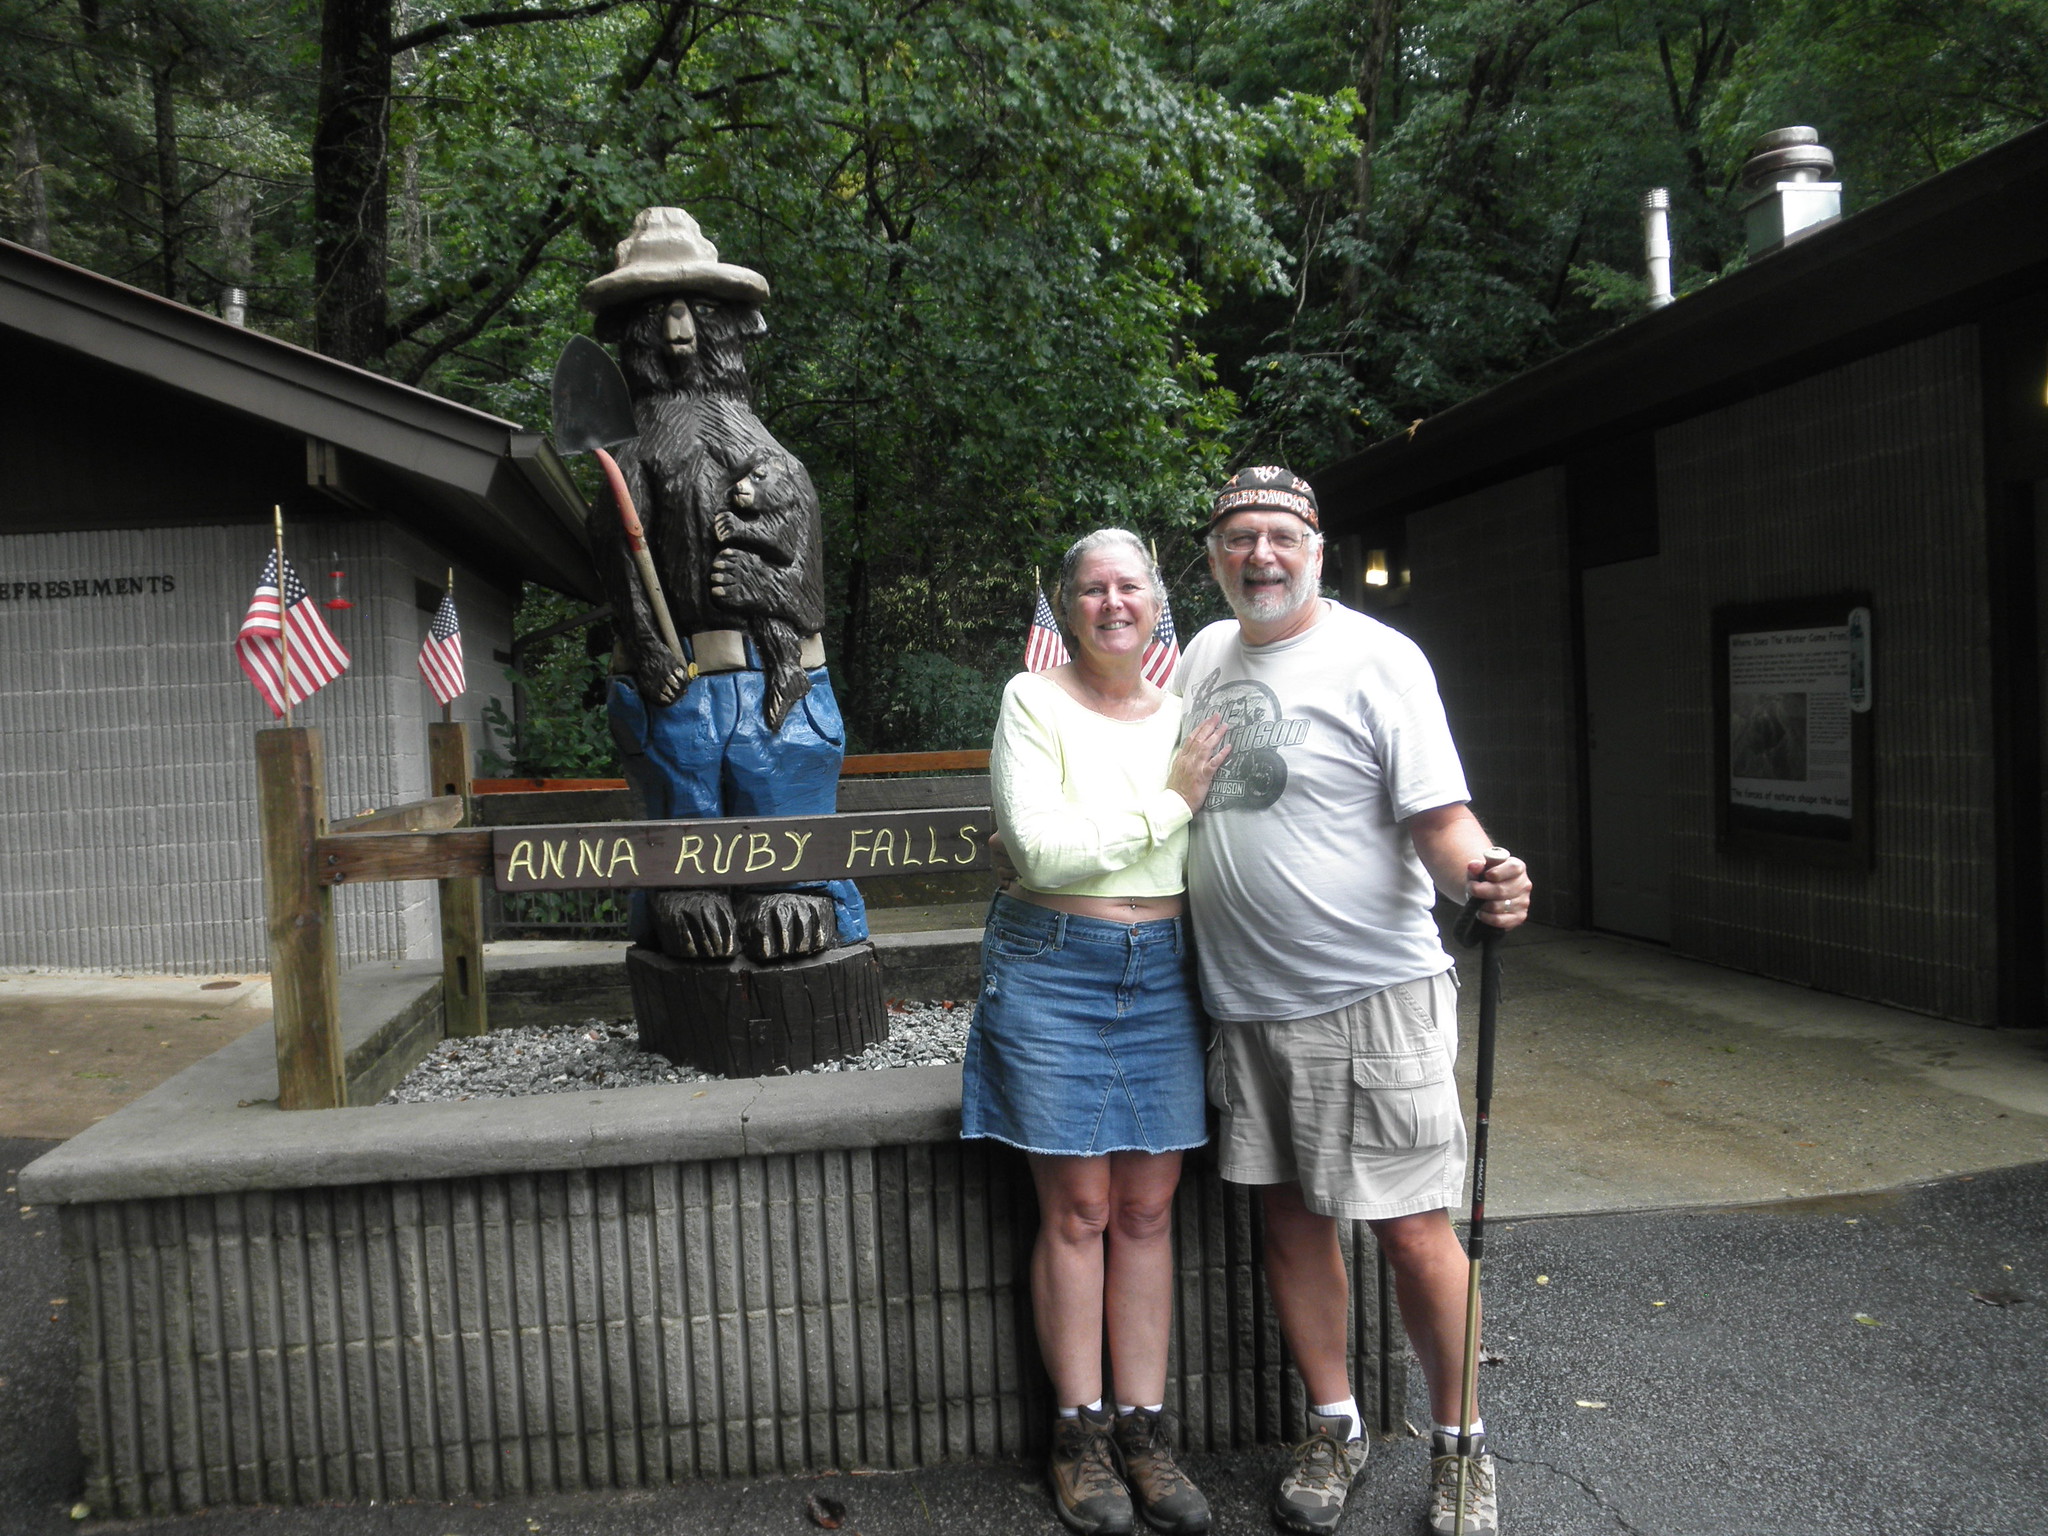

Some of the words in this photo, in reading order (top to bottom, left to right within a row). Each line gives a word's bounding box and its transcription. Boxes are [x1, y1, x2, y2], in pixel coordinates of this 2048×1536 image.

[1753, 637, 1769, 647] Does
[1771, 635, 1784, 645] The
[1786, 634, 1807, 644] Water
[1809, 632, 1827, 643] Come
[1729, 788, 1742, 797] The
[1764, 790, 1772, 800] of
[1820, 795, 1832, 804] the
[507, 837, 640, 882] ANNA
[674, 830, 813, 875] RUBY
[846, 825, 980, 869] FALLS
